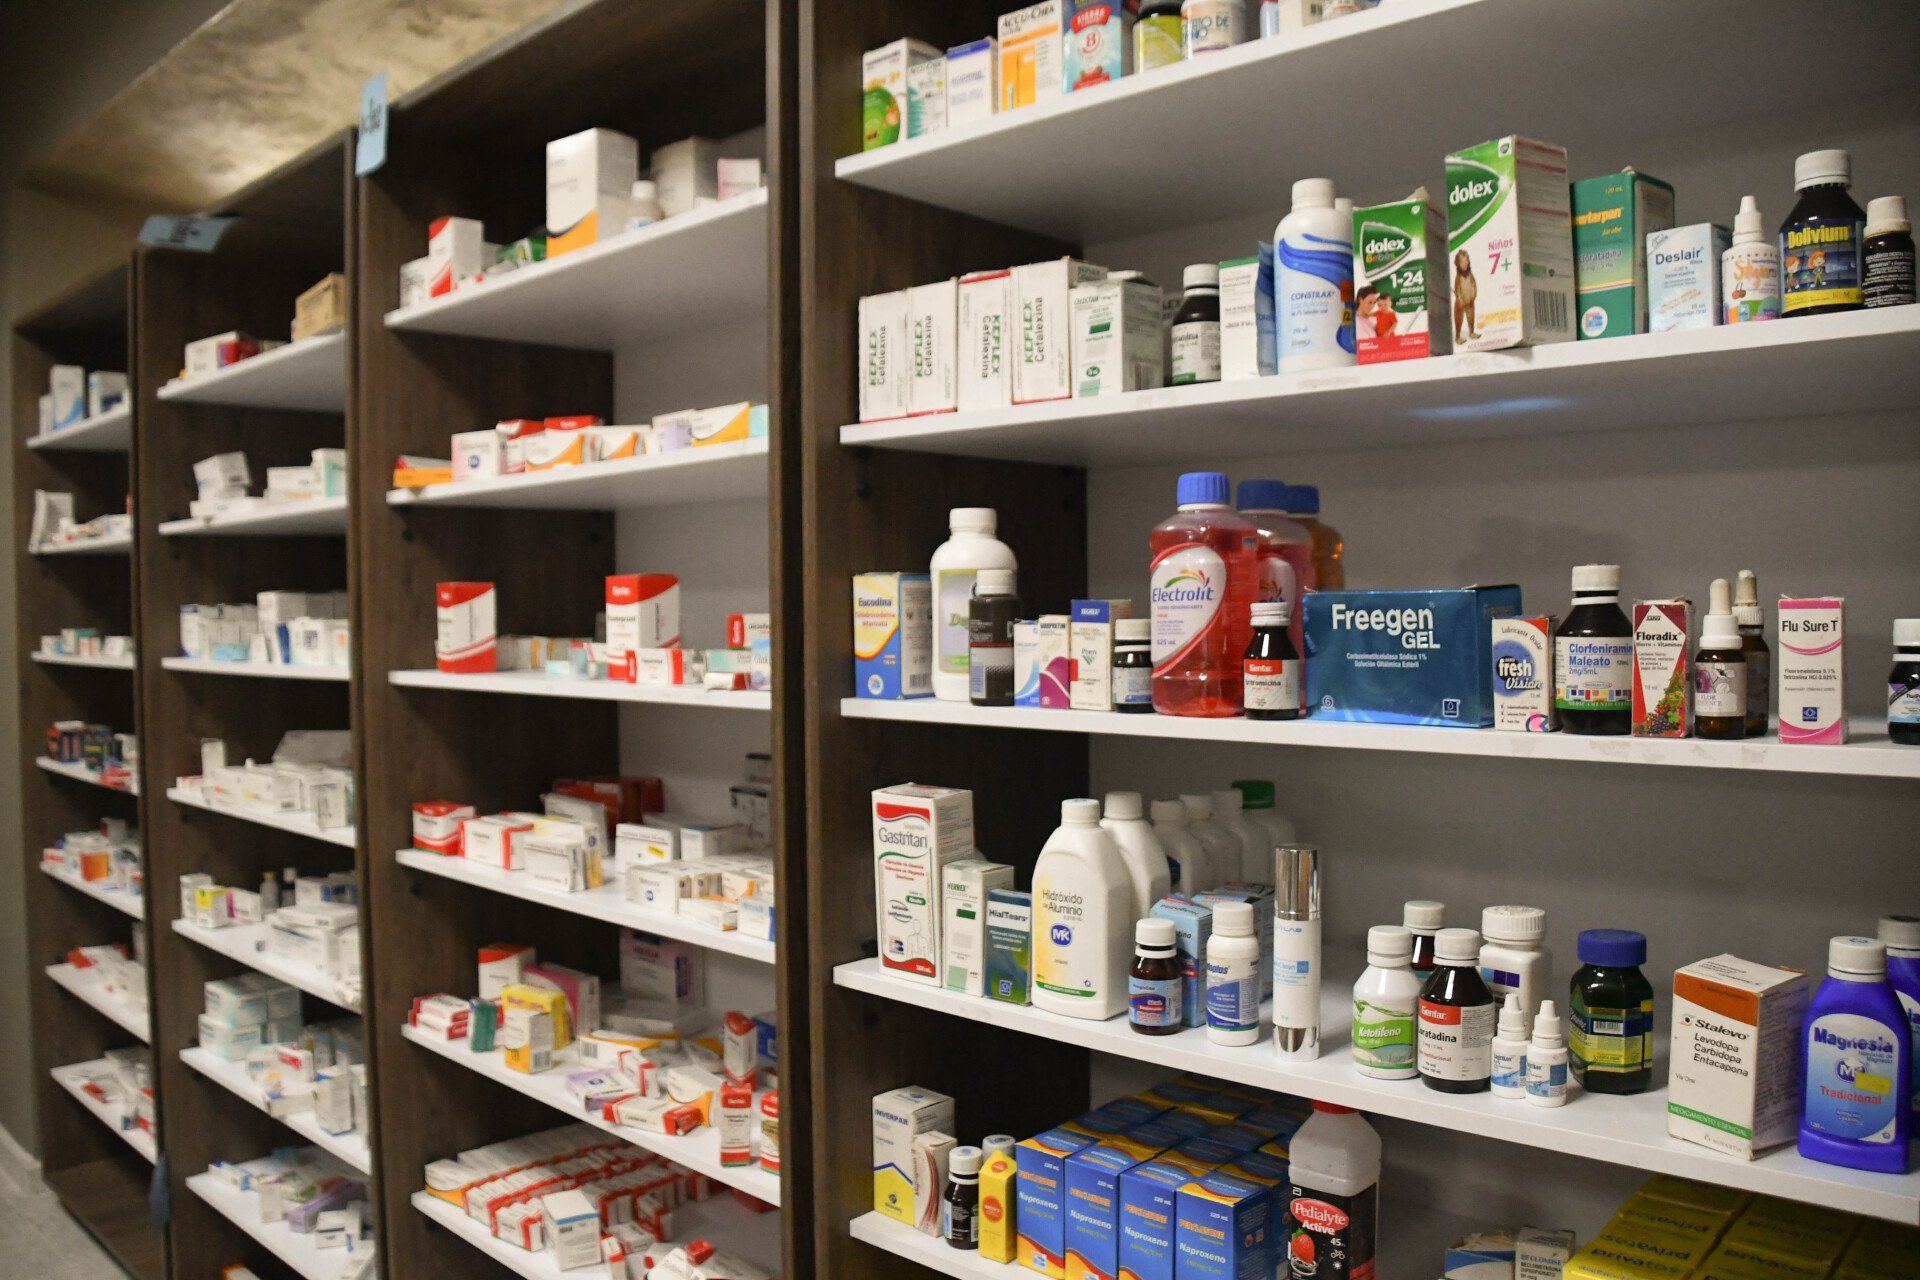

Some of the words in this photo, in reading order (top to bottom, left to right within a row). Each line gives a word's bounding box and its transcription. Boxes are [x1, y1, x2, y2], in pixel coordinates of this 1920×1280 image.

[1450, 181, 1493, 205] dolex
[1366, 238, 1406, 254] dolex
[1488, 238, 1513, 251] Niños
[1655, 249, 1701, 265] Deslair
[1390, 270, 1424, 288] 1-24
[1291, 291, 1332, 301] CONSTILAX
[1024, 302, 1033, 363] KEFLEX
[1035, 297, 1044, 362] Cefalexina
[915, 321, 923, 377] KEFLEX
[924, 315, 932, 376] Cefalexina
[982, 316, 991, 378] Cefalexina
[992, 315, 1000, 374] KEFLEX
[869, 329, 877, 386] KEFLEX
[878, 326, 887, 385] Cefalexina
[1152, 586, 1214, 601] Electrolit
[1332, 603, 1434, 636] Freegen
[1782, 620, 1798, 632] Flu
[1803, 620, 1829, 632] Sure
[1831, 620, 1838, 631] T
[1402, 631, 1441, 649] GEL
[1501, 626, 1528, 637] Lubricante
[1636, 632, 1678, 641] Floradix
[1569, 643, 1632, 654] Clorfeniramin
[1498, 659, 1532, 677] fresh
[1569, 655, 1610, 667] Maleato
[1506, 678, 1541, 690] Vision
[879, 827, 928, 849] Gastritan
[1043, 889, 1082, 905] Hidróxido
[989, 909, 1026, 922] HialTears
[1048, 902, 1082, 916] Aluminio
[1053, 929, 1069, 941] MK
[1695, 1019, 1747, 1041] Stalevo
[1694, 1033, 1739, 1053] Levodopa
[1814, 1027, 1893, 1053] Magnesia
[1694, 1043, 1741, 1064] Carbidopa
[1693, 1053, 1749, 1077] Entacapona
[1820, 1085, 1882, 1104] Tradicional
[1019, 1191, 1059, 1210] Naproxeno
[1070, 1209, 1112, 1230] Naproxeno
[1295, 1203, 1346, 1226] Pedialyte
[1124, 1226, 1169, 1247] Naproxeno
[1302, 1219, 1335, 1235] Active
[1331, 1237, 1342, 1247] 45
[1179, 1242, 1226, 1265] Naproxeno
